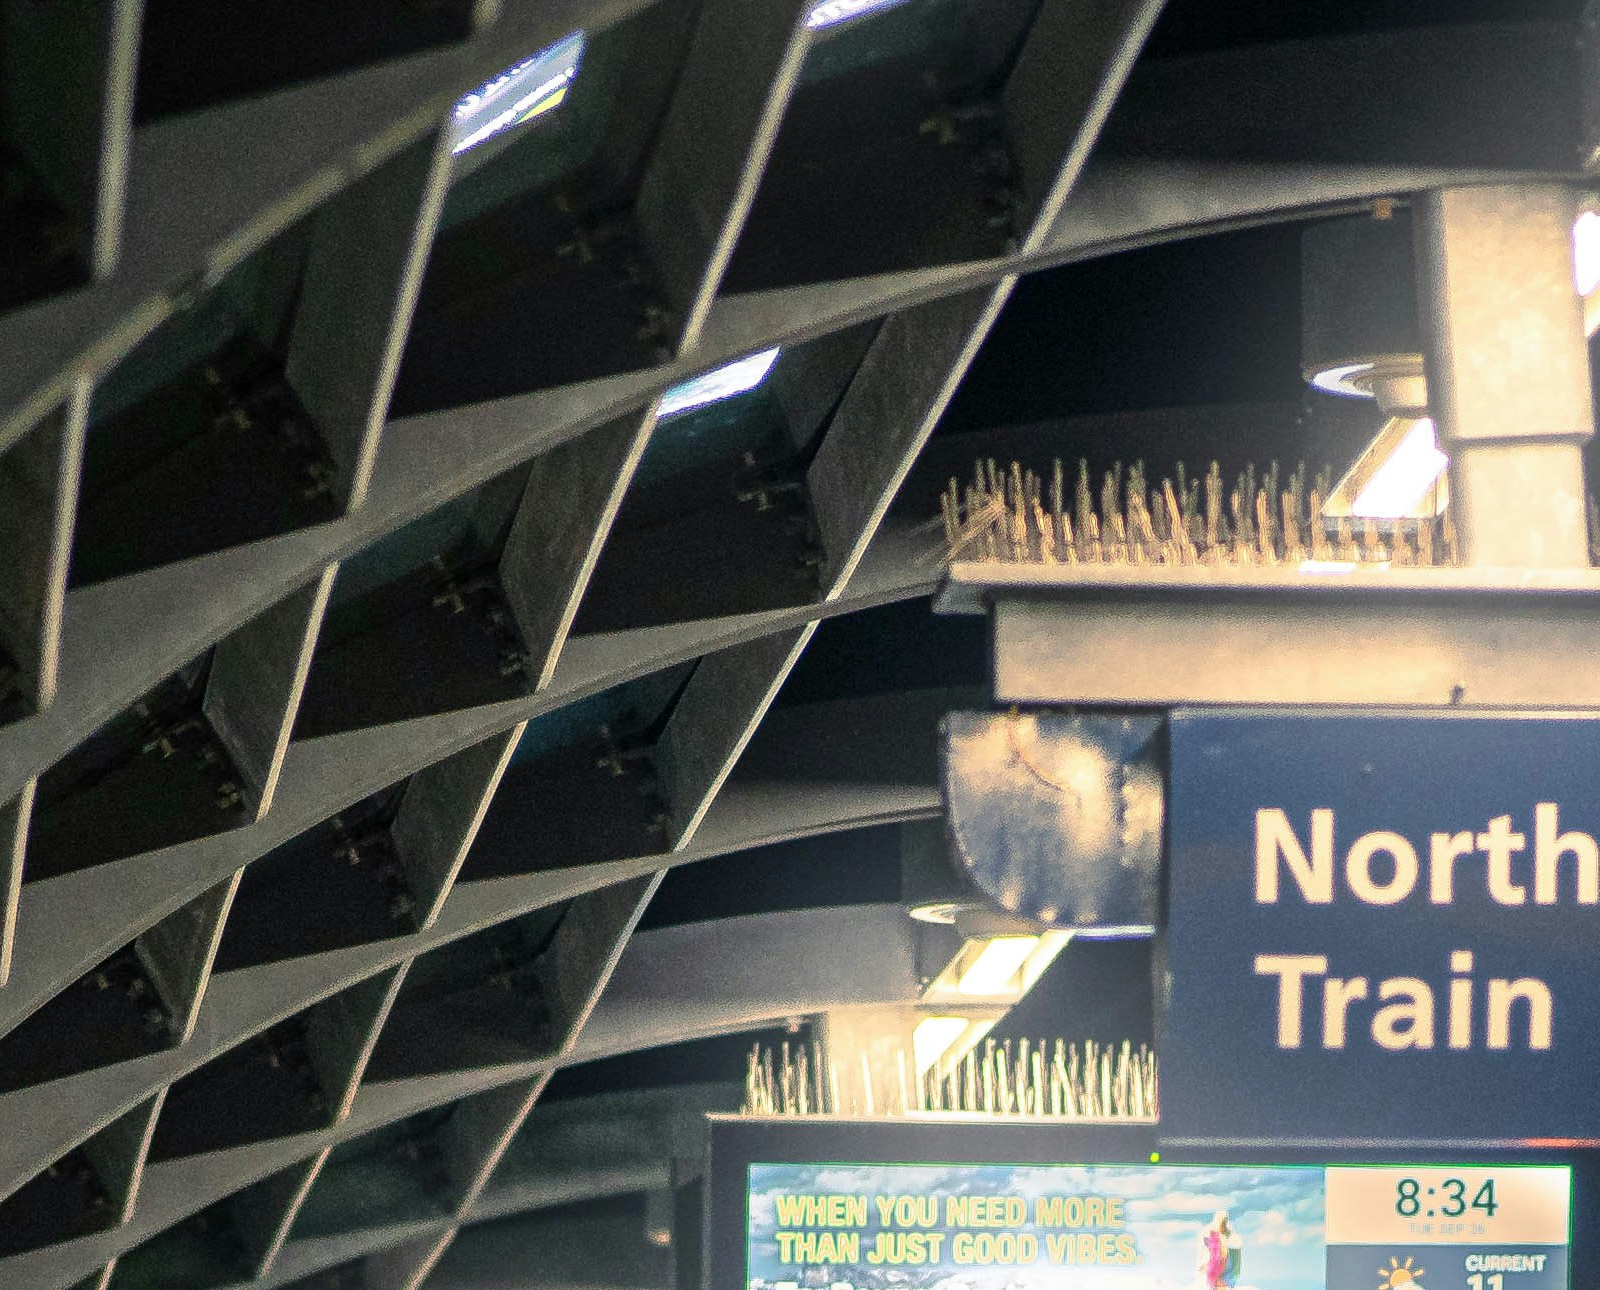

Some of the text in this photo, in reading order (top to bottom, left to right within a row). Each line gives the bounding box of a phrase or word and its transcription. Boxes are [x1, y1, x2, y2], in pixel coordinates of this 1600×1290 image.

[1254, 951, 1552, 1049] Train
[776, 1195, 1127, 1228] WHEN YOU NEED MORE
[1395, 1178, 1498, 1217] 8:34
[776, 1232, 1144, 1266] THAN JUST GOOD VIBES.
[1465, 1254, 1546, 1272] CURRENT
